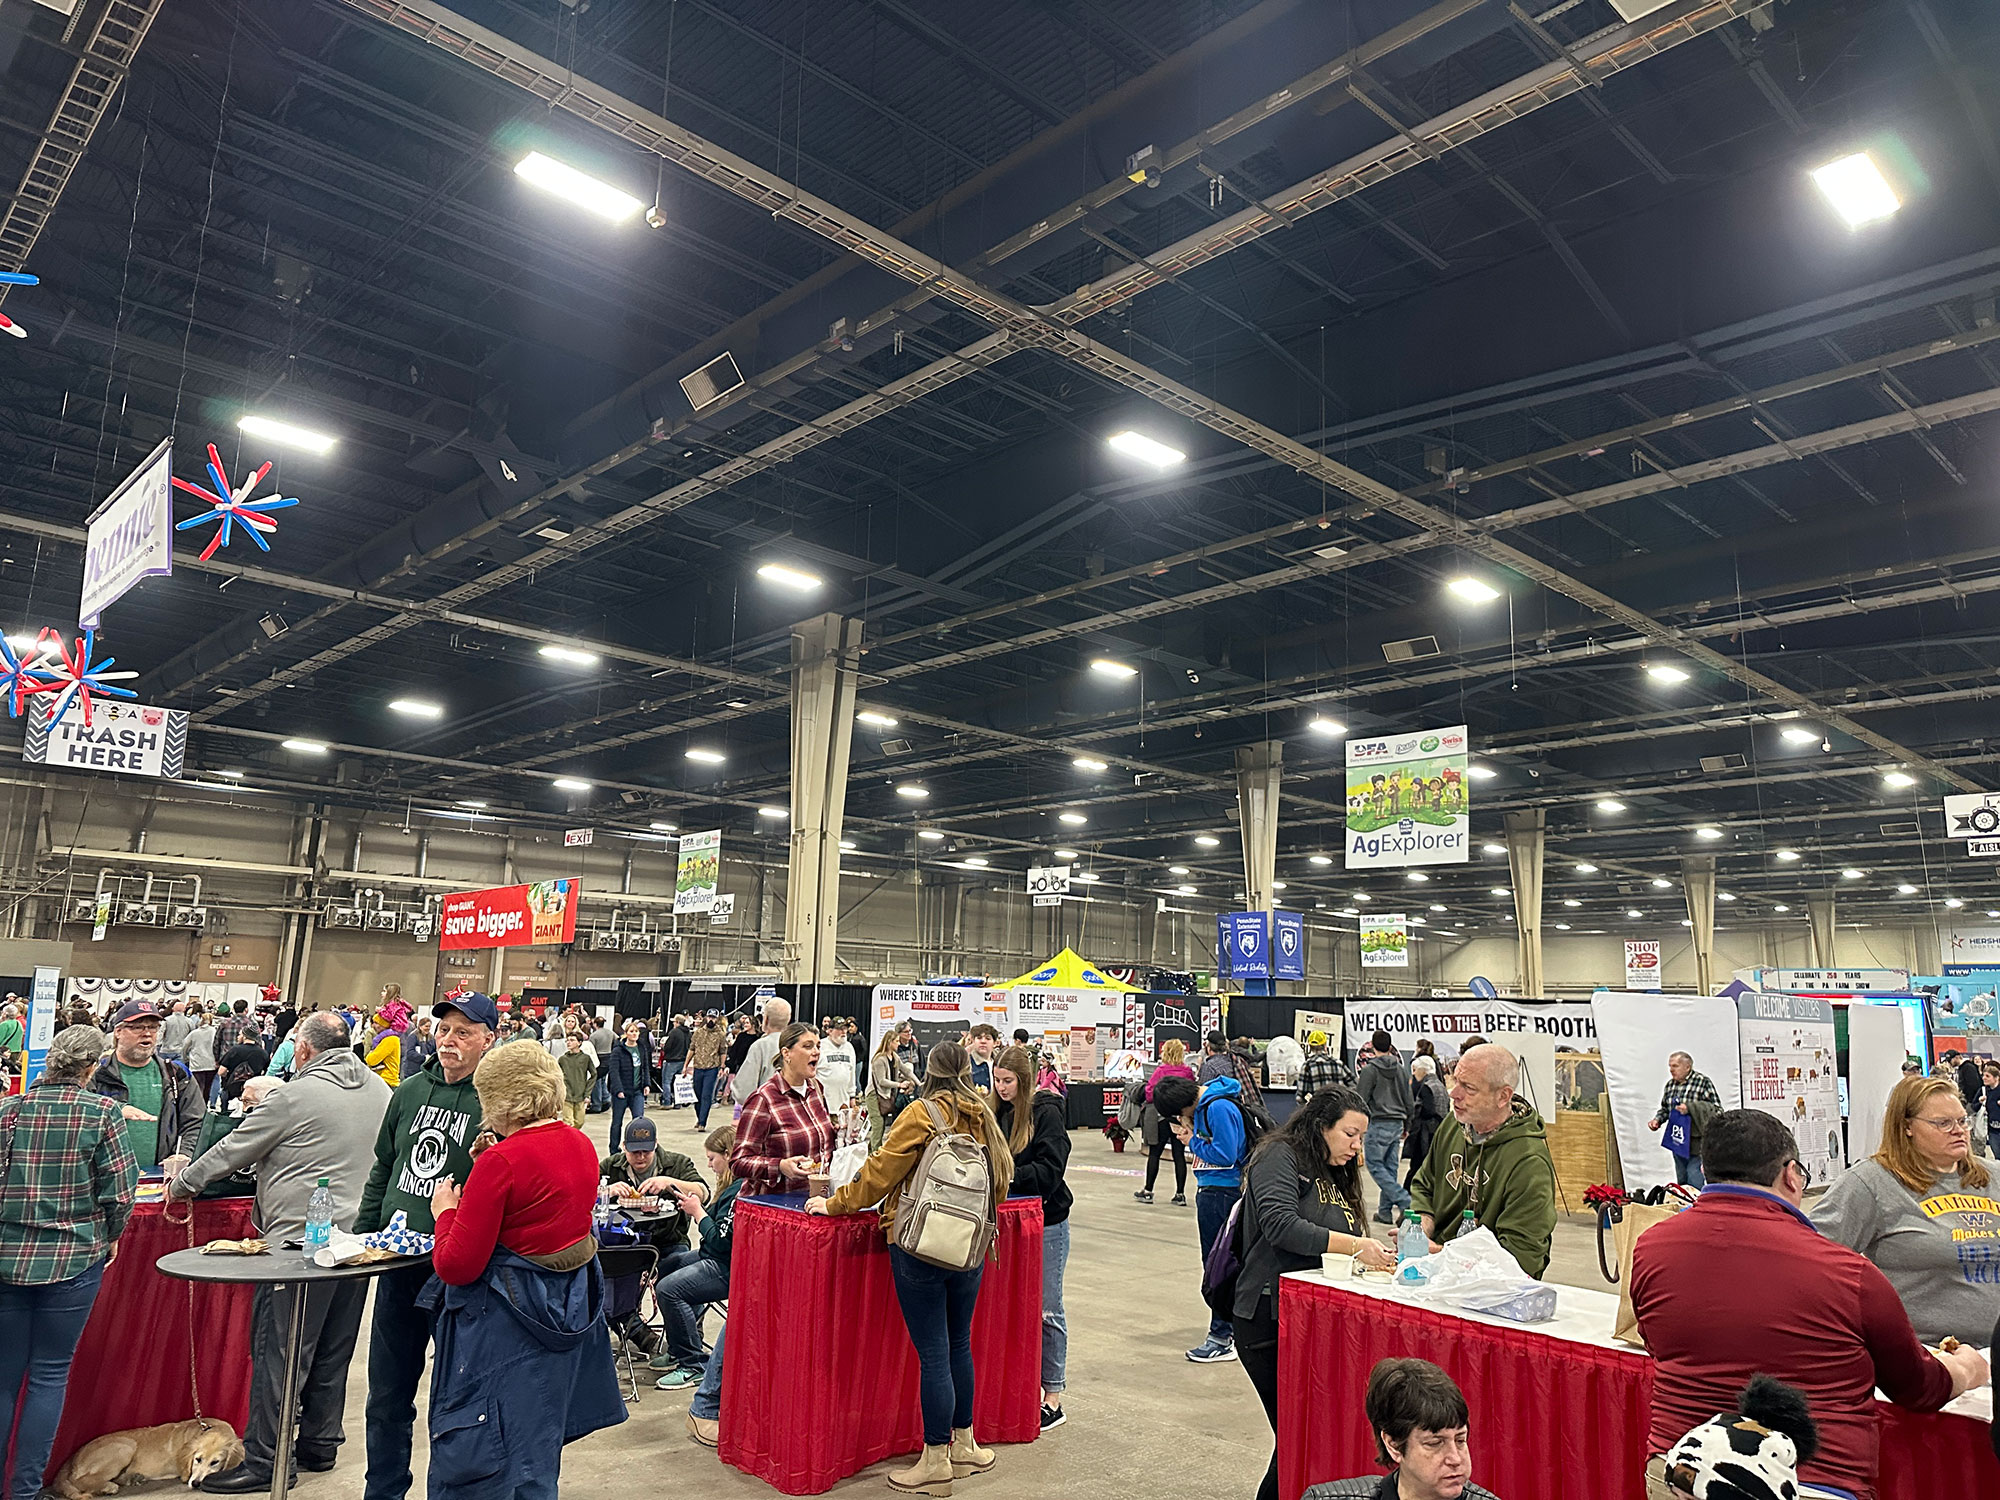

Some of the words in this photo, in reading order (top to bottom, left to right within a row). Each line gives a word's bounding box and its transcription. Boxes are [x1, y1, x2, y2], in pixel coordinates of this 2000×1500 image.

[127, 709, 138, 719] A
[58, 721, 158, 751] TRASH
[67, 744, 144, 770] HERE
[570, 833, 592, 845] EXIT
[1352, 831, 1464, 858] AgExplorer
[676, 892, 714, 908] AgExplorer
[445, 913, 476, 936] save
[477, 906, 524, 938] bigger.
[534, 924, 562, 938] GIANT
[1626, 942, 1659, 953] SHOP
[1363, 953, 1406, 963] AgExplorer
[1855, 982, 1870, 990] SHOW
[530, 997, 549, 1005] GIANT
[880, 989, 917, 1001] WHERE'S
[919, 991, 936, 1002] THE
[938, 992, 962, 1003] BEEF?
[1019, 993, 1045, 1010] BEEF
[1046, 994, 1056, 1002] FOR
[1057, 995, 1065, 1003] ALL
[1066, 995, 1078, 1003] AGES
[1046, 1003, 1051, 1011] &
[1051, 1003, 1069, 1011] STAGES
[1754, 995, 1791, 1018] WELCOME
[1794, 999, 1821, 1017] VISITORS
[1351, 1013, 1430, 1033] WELCOME
[1434, 1016, 1451, 1032] TO
[1454, 1016, 1479, 1032] THE
[1485, 1013, 1527, 1033] BEEF
[1534, 1016, 1597, 1038] BOOTH
[1301, 1029, 1335, 1047] MT
[1753, 1067, 1761, 1079] THE
[1762, 1058, 1779, 1078] BEEF
[1750, 1080, 1785, 1101] LIFECYCLE
[1959, 1213, 1986, 1227] W
[1951, 1227, 1995, 1242] Makes
